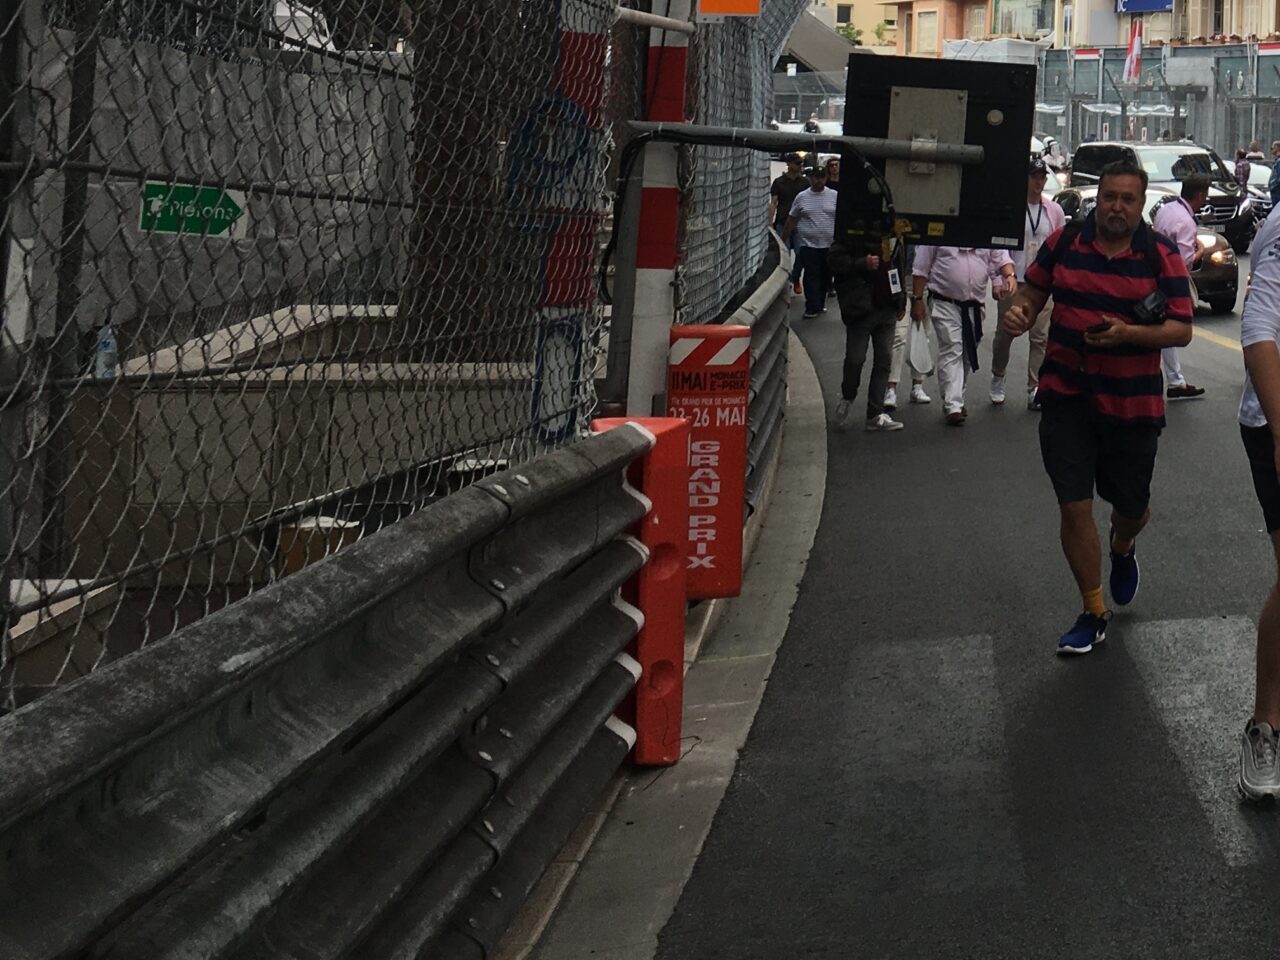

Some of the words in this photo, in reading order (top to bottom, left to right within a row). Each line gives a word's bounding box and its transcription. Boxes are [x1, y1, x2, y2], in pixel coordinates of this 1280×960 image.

[716, 406, 746, 427] MAI
[687, 440, 721, 508] GRAND
[685, 514, 717, 569] PRIX
